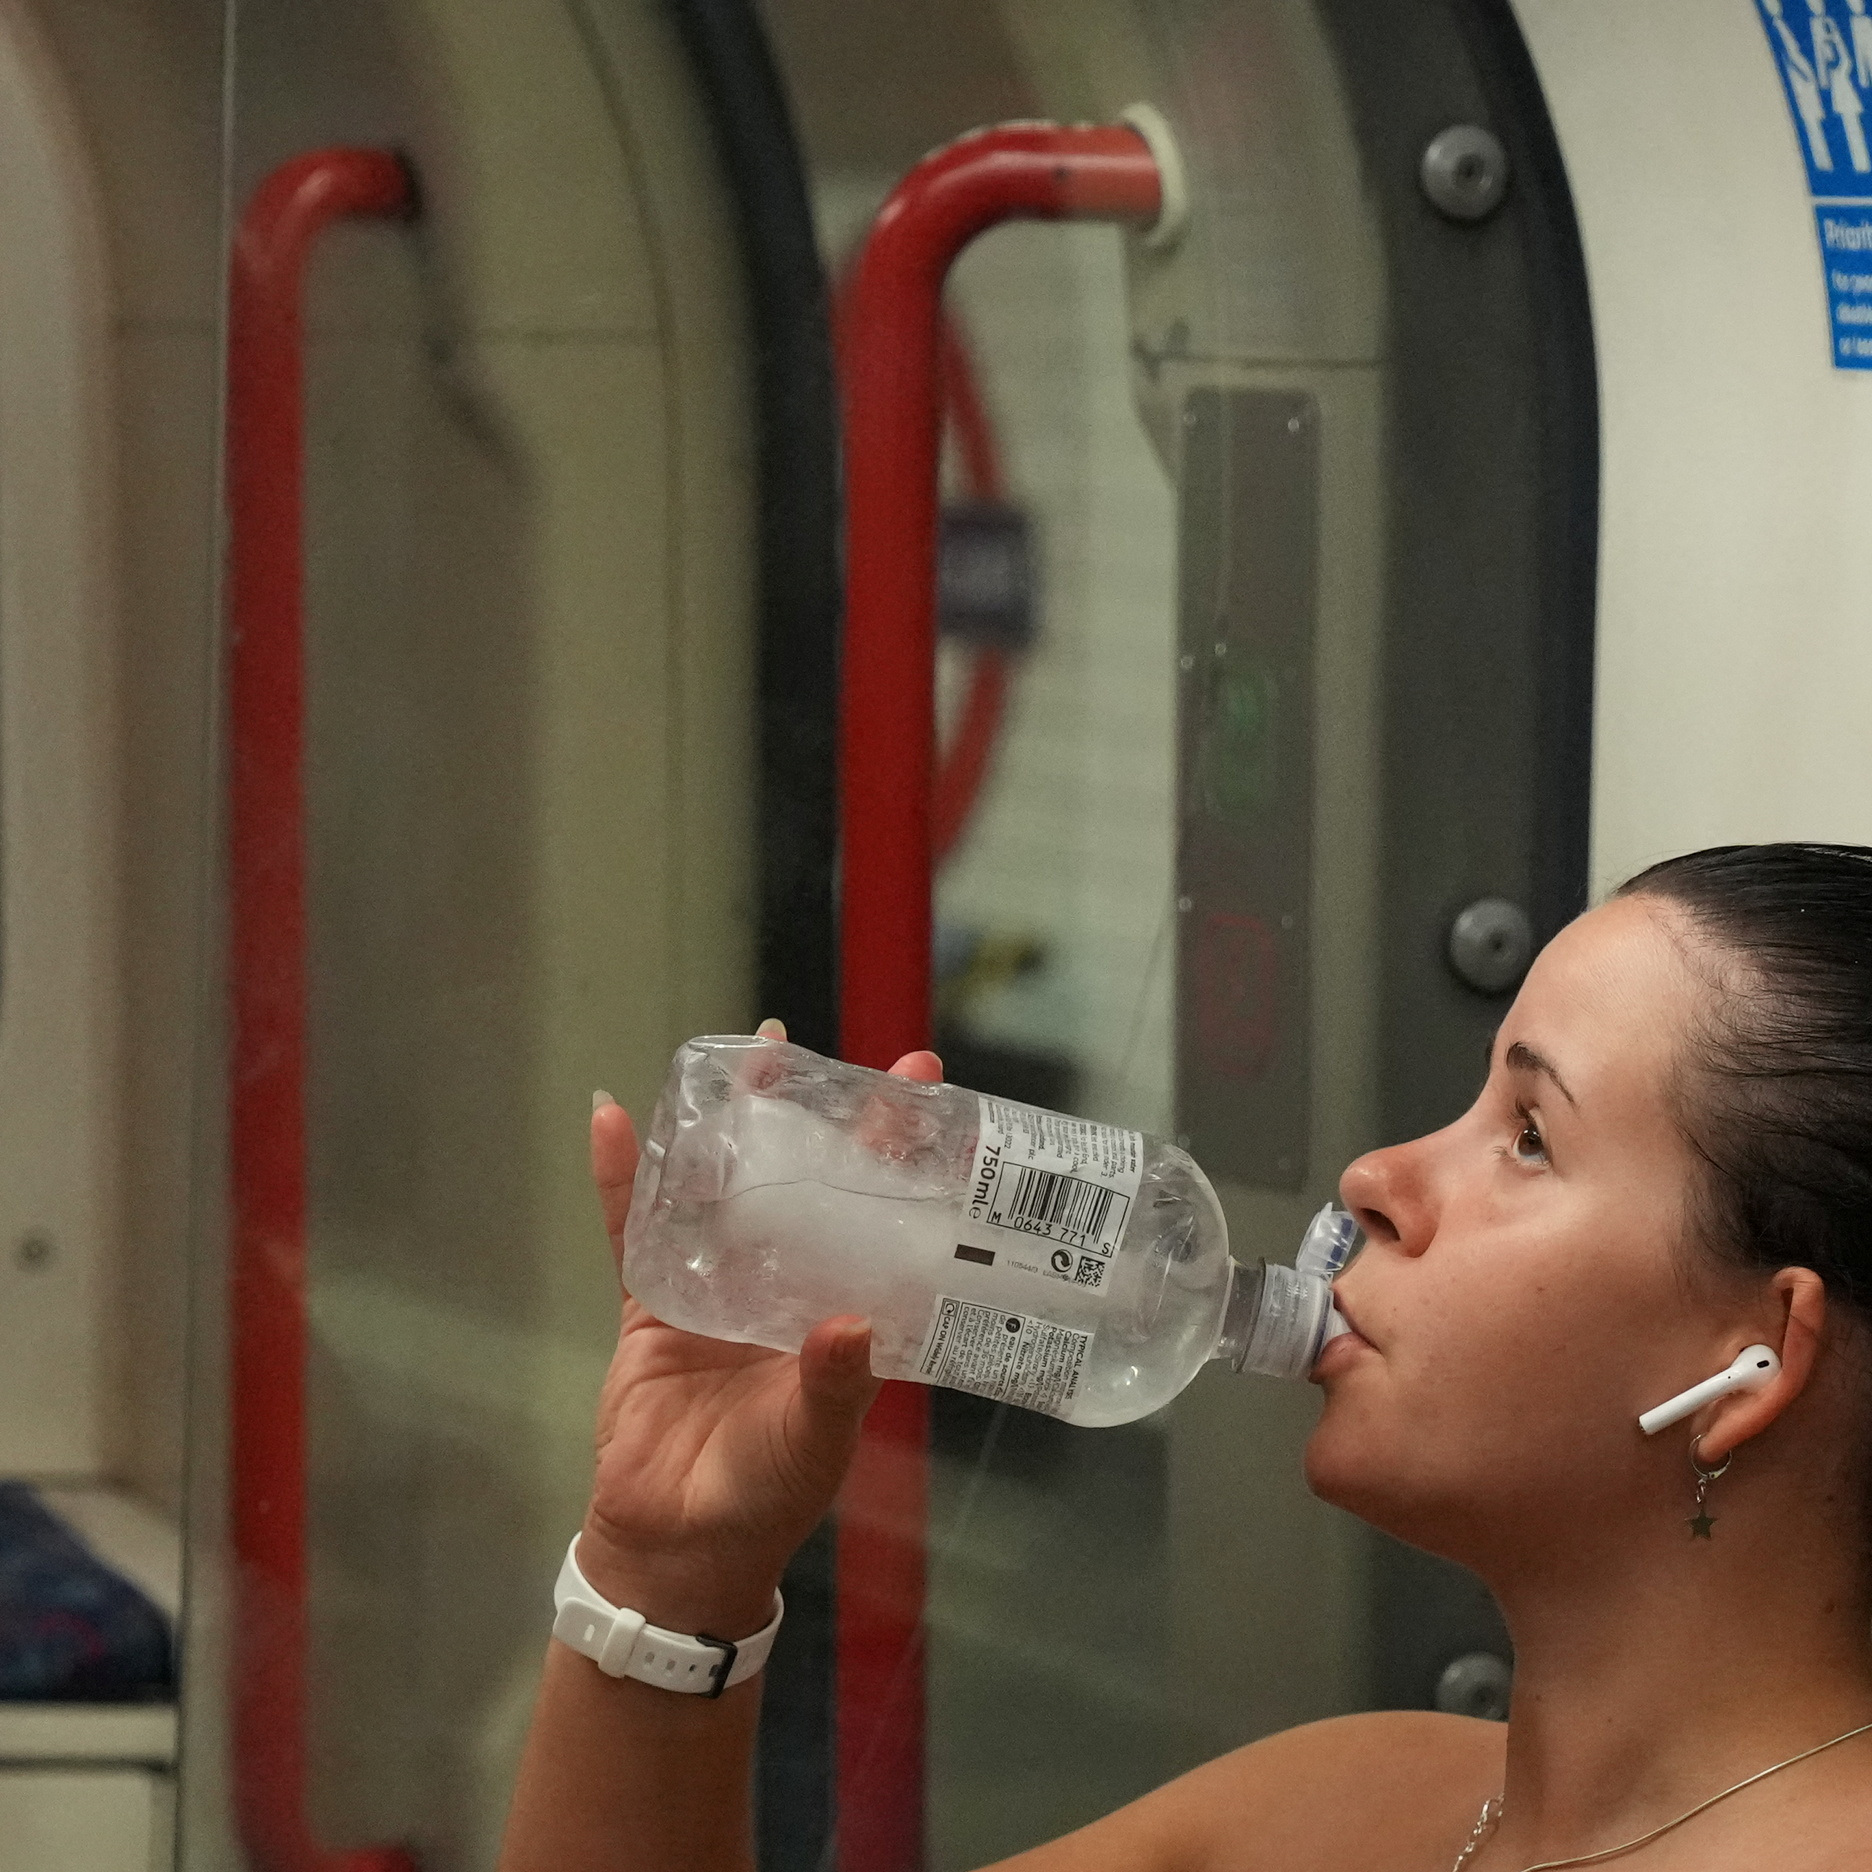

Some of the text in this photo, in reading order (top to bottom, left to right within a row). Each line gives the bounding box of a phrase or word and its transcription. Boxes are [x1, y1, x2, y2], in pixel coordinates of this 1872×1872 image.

[991, 1211, 1111, 1255] M 0643 771 S
[939, 1330, 947, 1341] ON
[956, 1307, 970, 1343] conserver
[969, 1309, 985, 1347] Conserver
[976, 1311, 992, 1352] préférence
[988, 1313, 1000, 1336] moins
[959, 1350, 966, 1360] de
[981, 1349, 989, 1360] 36
[984, 1337, 993, 1348] de
[1008, 1336, 1016, 1350] eau
[1016, 1342, 1029, 1370] Nitrate
[1041, 1326, 1057, 1367] Potassium
[1059, 1331, 1072, 1362] Calcium
[1063, 1333, 1080, 1380] Composition
[1074, 1336, 1087, 1368] TYPICAL
[969, 1354, 980, 1374] avant
[1004, 1352, 1012, 1363] de
